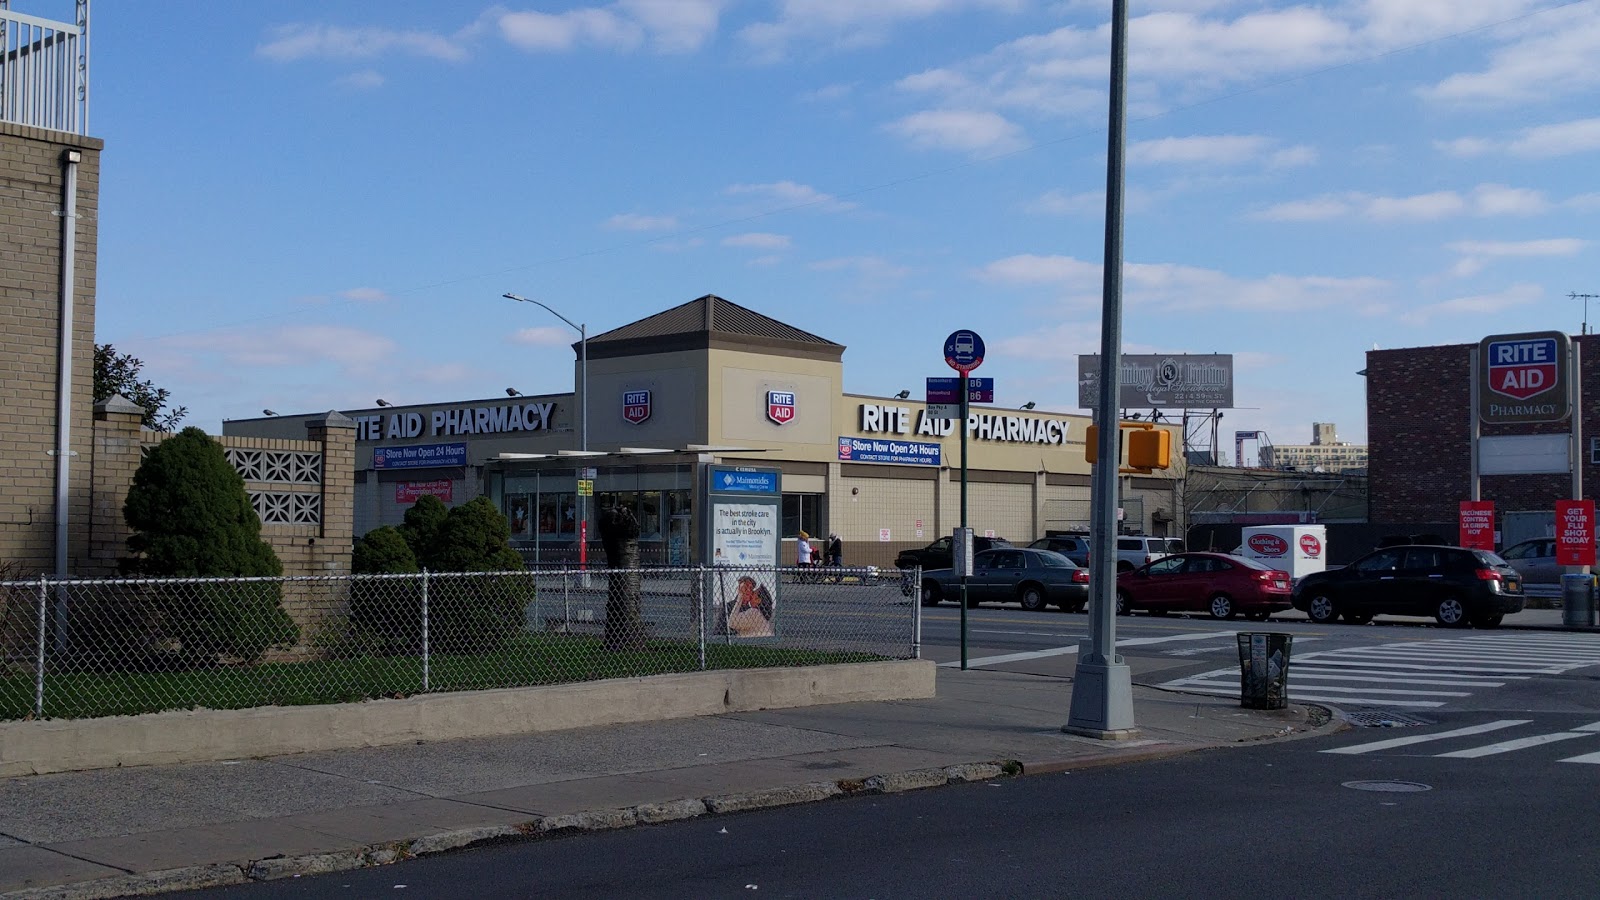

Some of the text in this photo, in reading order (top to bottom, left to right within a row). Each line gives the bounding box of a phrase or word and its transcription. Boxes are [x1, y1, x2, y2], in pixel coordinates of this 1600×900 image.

[1498, 343, 1547, 363] RITE
[1186, 363, 1226, 386] Lighting
[1502, 369, 1544, 389] AID
[970, 379, 982, 388] B6
[627, 393, 645, 404] RITE
[773, 394, 791, 404] RITE
[970, 391, 981, 400] B6
[629, 407, 644, 417] AID
[775, 408, 790, 418] AID
[387, 413, 421, 438] AID
[431, 403, 553, 436] PHARMACY
[863, 404, 1070, 444] RITE AID PHARMACY
[386, 446, 464, 459] Store Now Open 24 Hours
[853, 440, 939, 455] Store Now Open 24 Hours
[736, 476, 769, 484] Maimonides
[747, 519, 756, 528] city
[722, 528, 741, 536] actually
[748, 528, 772, 536] Brooklyn.
[1252, 538, 1275, 546] Clothing
